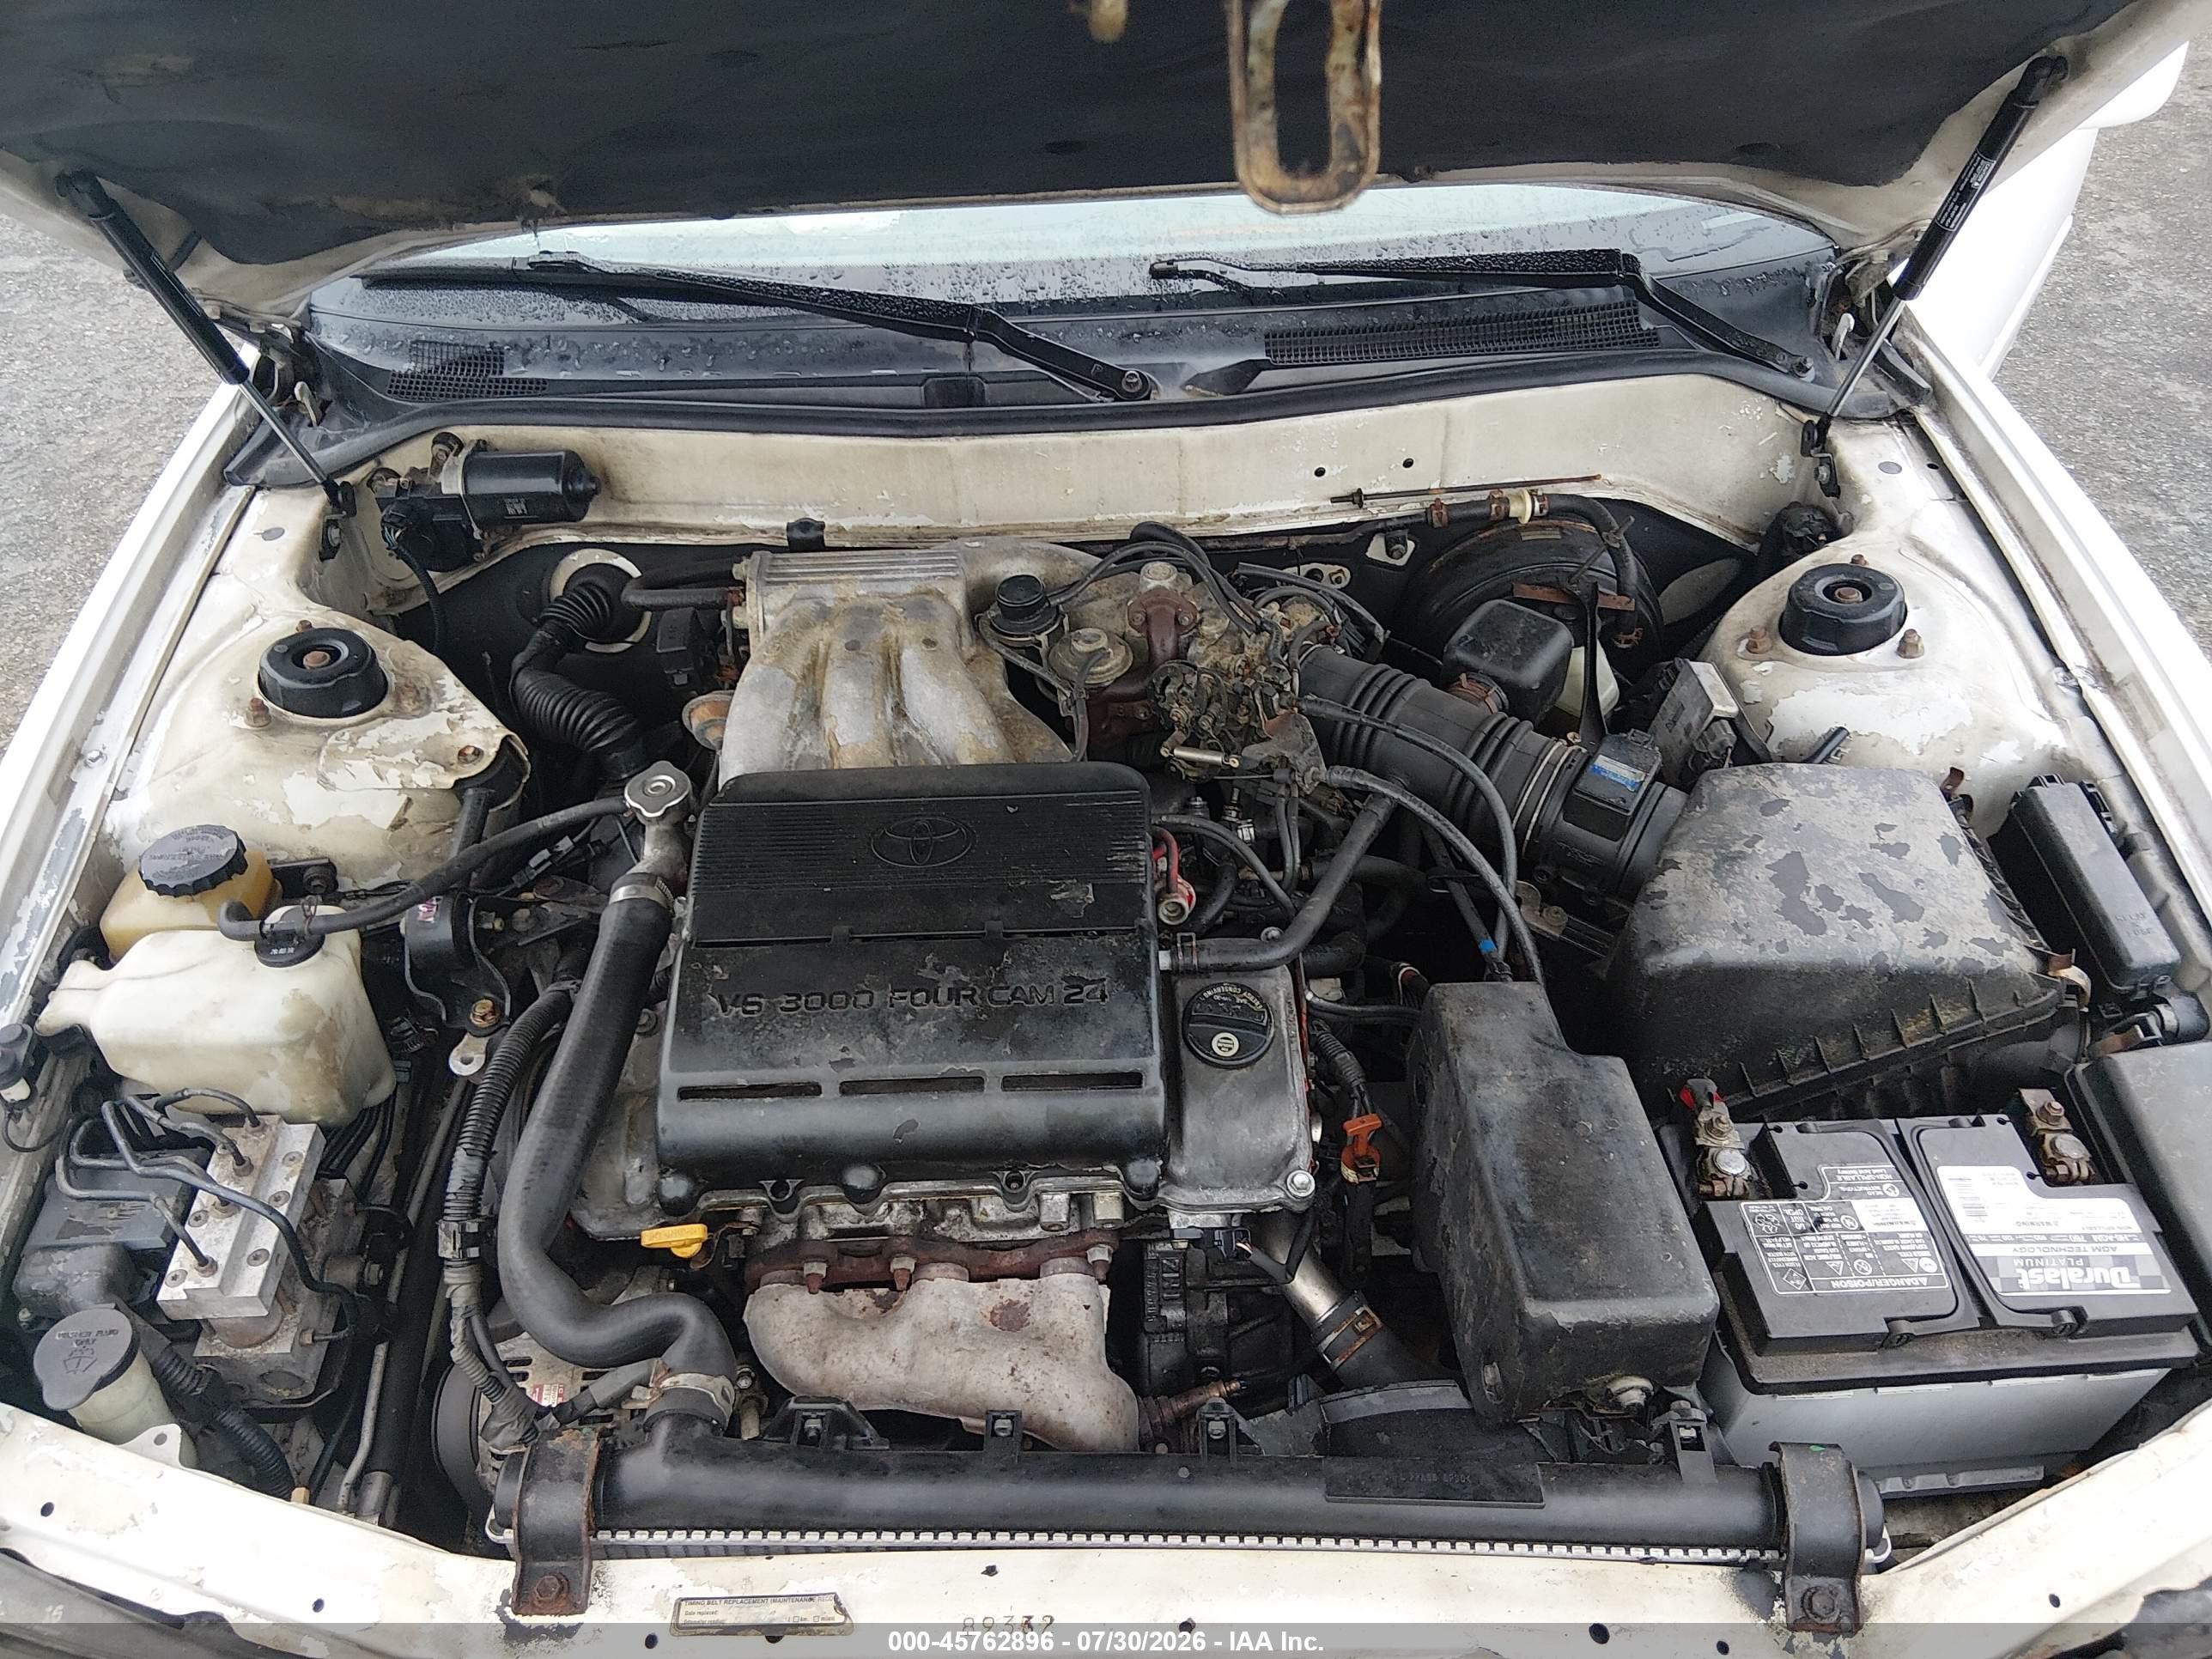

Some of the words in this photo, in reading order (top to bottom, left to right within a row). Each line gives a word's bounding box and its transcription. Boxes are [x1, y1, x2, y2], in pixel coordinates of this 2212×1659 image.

[777, 990, 874, 1013] 3000
[888, 987, 981, 1009] FOUR
[986, 984, 1055, 1007] CAM
[1062, 978, 1111, 1006] 24
[2013, 1257, 2083, 1267] PLATINUM
[1830, 1277, 1920, 1288] DANGER/POISON
[2015, 1267, 2141, 1291] Duralast
